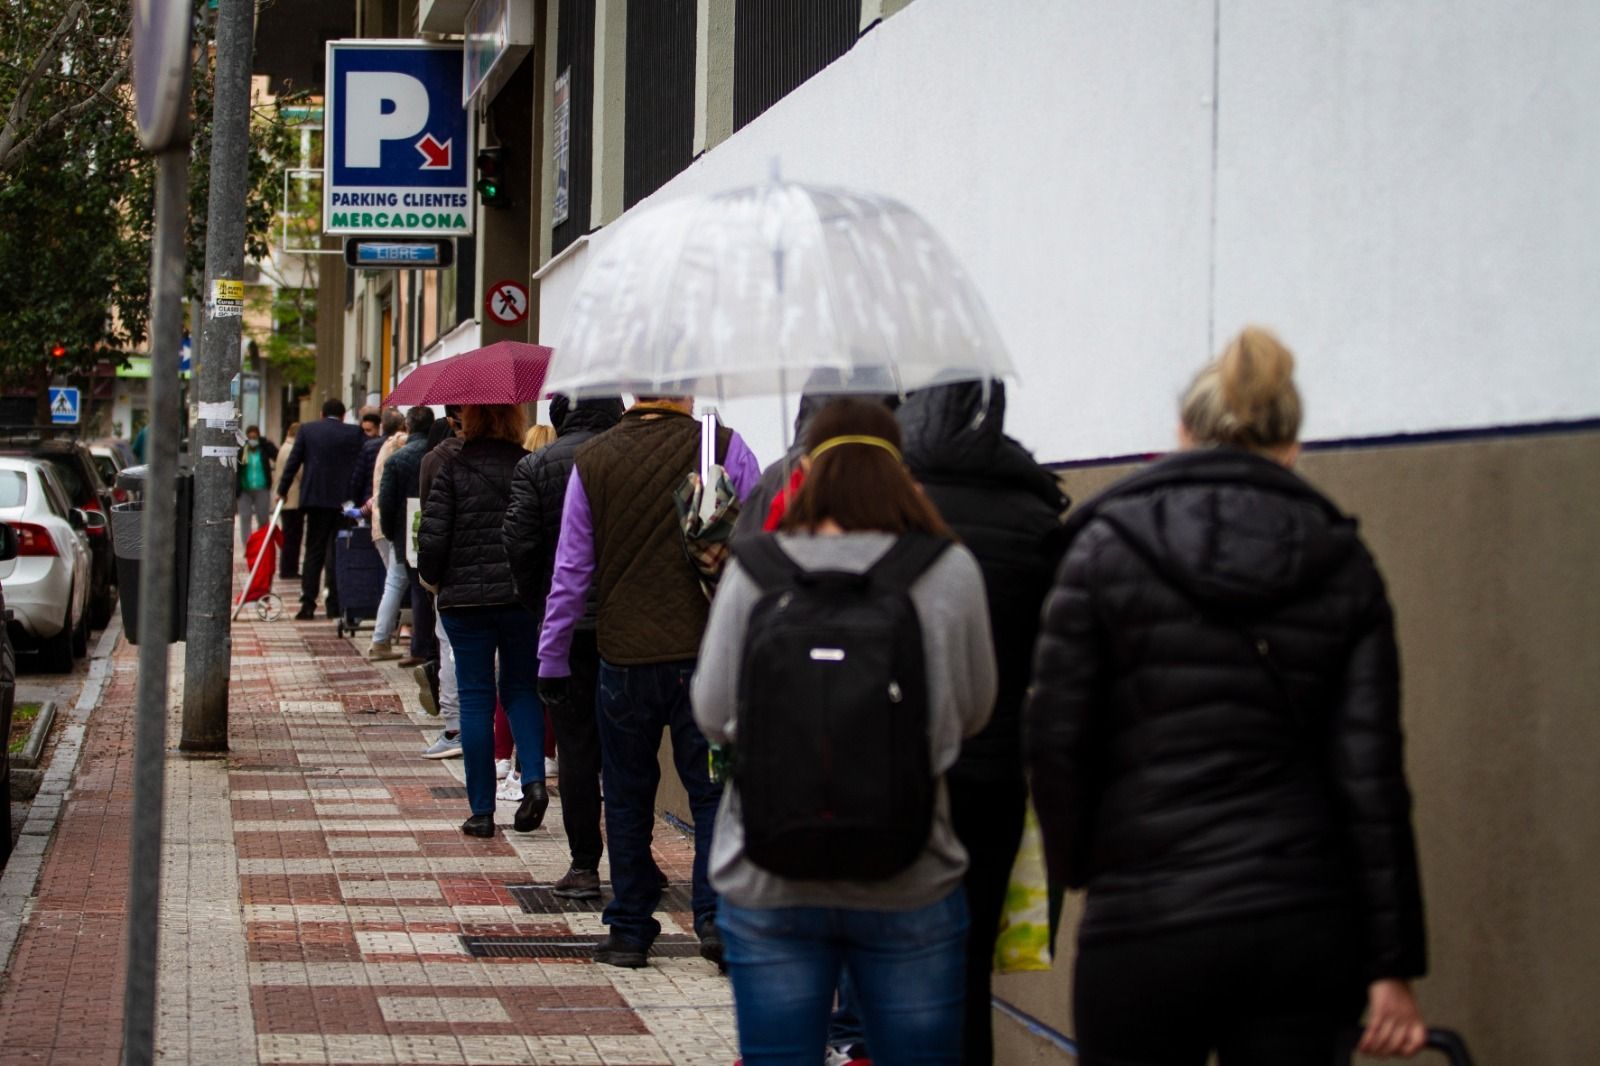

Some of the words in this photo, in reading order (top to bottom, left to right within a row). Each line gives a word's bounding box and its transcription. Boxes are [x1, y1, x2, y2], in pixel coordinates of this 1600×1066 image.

[345, 71, 430, 168] P
[332, 193, 398, 207] PARKING
[403, 193, 467, 207] CLIENTES
[331, 212, 467, 228] MERCADONA
[377, 246, 418, 259] LIBRE
